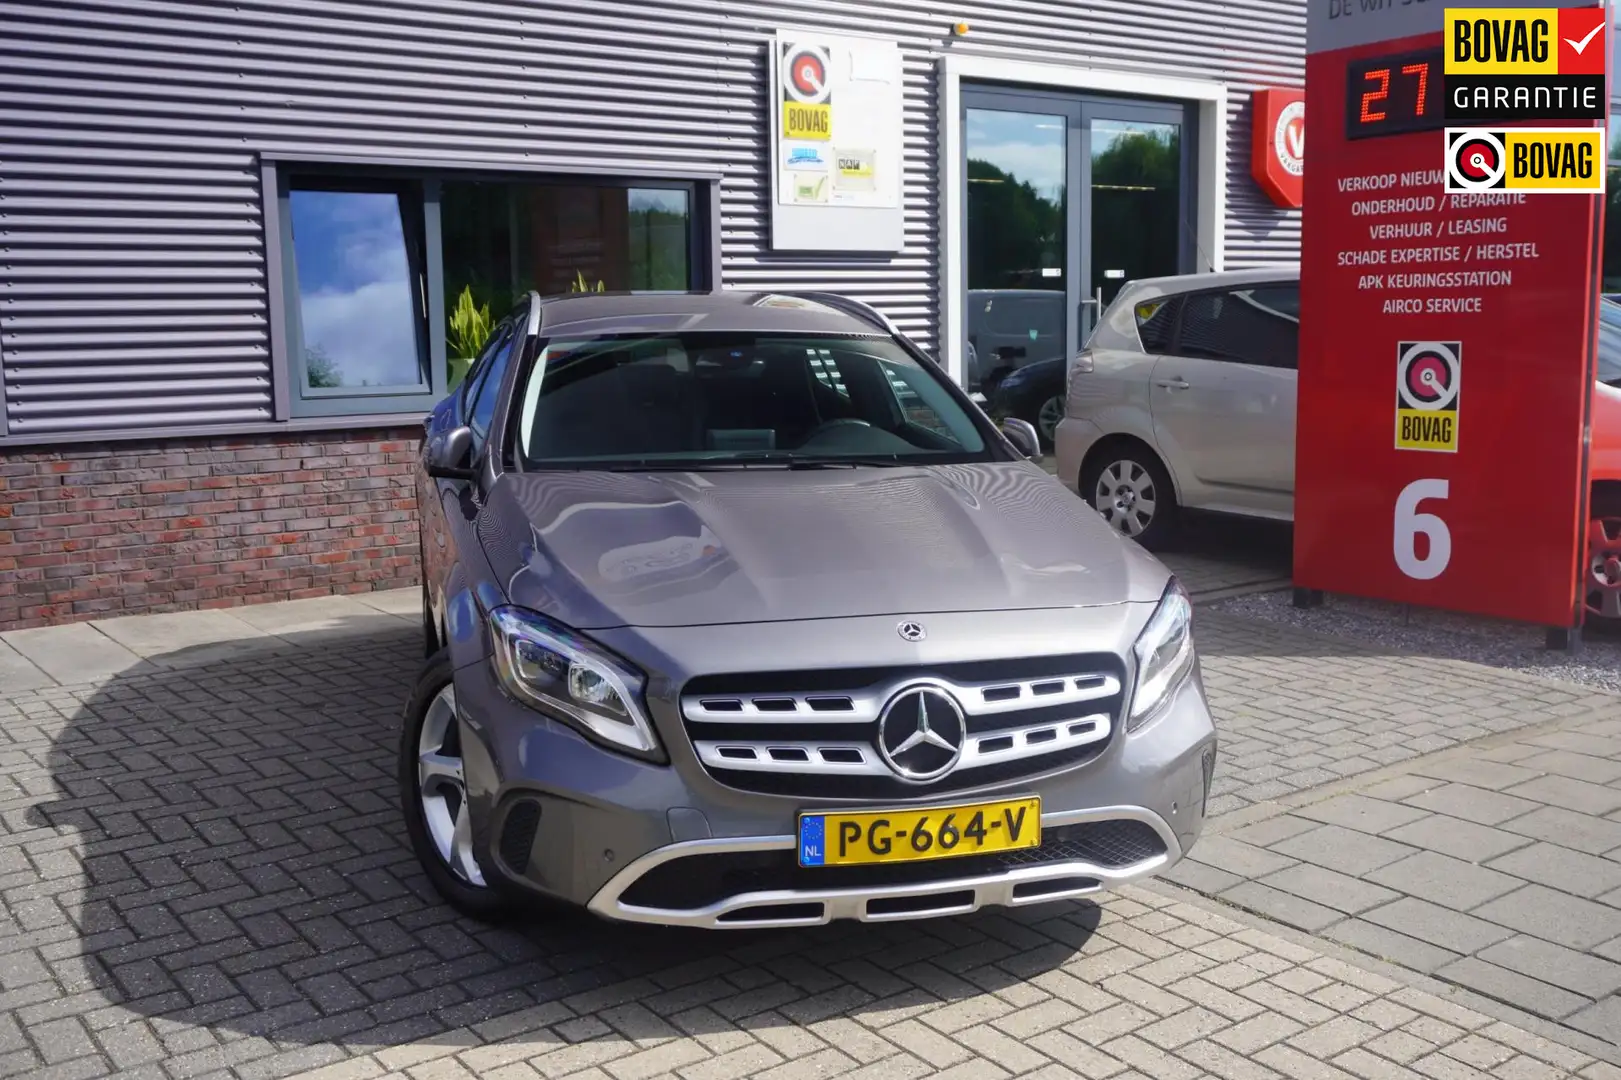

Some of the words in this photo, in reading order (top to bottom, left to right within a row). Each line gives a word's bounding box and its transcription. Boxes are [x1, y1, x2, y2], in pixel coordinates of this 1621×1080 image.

[1328, 0, 1352, 19] DE
[1360, 62, 1429, 123] 27
[788, 107, 829, 133] BOVAG
[1338, 173, 1397, 192] VERKOOP
[1352, 196, 1435, 216] ONDERHOUD
[1439, 196, 1446, 212] /
[1450, 193, 1526, 209] REPARATIE
[1370, 224, 1432, 240] VERHUUR
[1436, 221, 1445, 238] /
[1448, 217, 1507, 235] LEASING
[1337, 250, 1387, 266] SCHADE
[1391, 246, 1460, 264] EXPERTISE
[1464, 246, 1472, 262] /
[1476, 243, 1539, 260] HERSTEL
[1358, 275, 1384, 289] APK
[1387, 271, 1512, 288] KEURINGSSTATION
[1383, 299, 1422, 314] AIRCO
[1426, 297, 1482, 313] SERVICE
[1401, 415, 1452, 443] BOVAG
[1393, 478, 1452, 580] 6
[805, 846, 821, 857] NL
[839, 806, 1027, 857] PG-664-V
